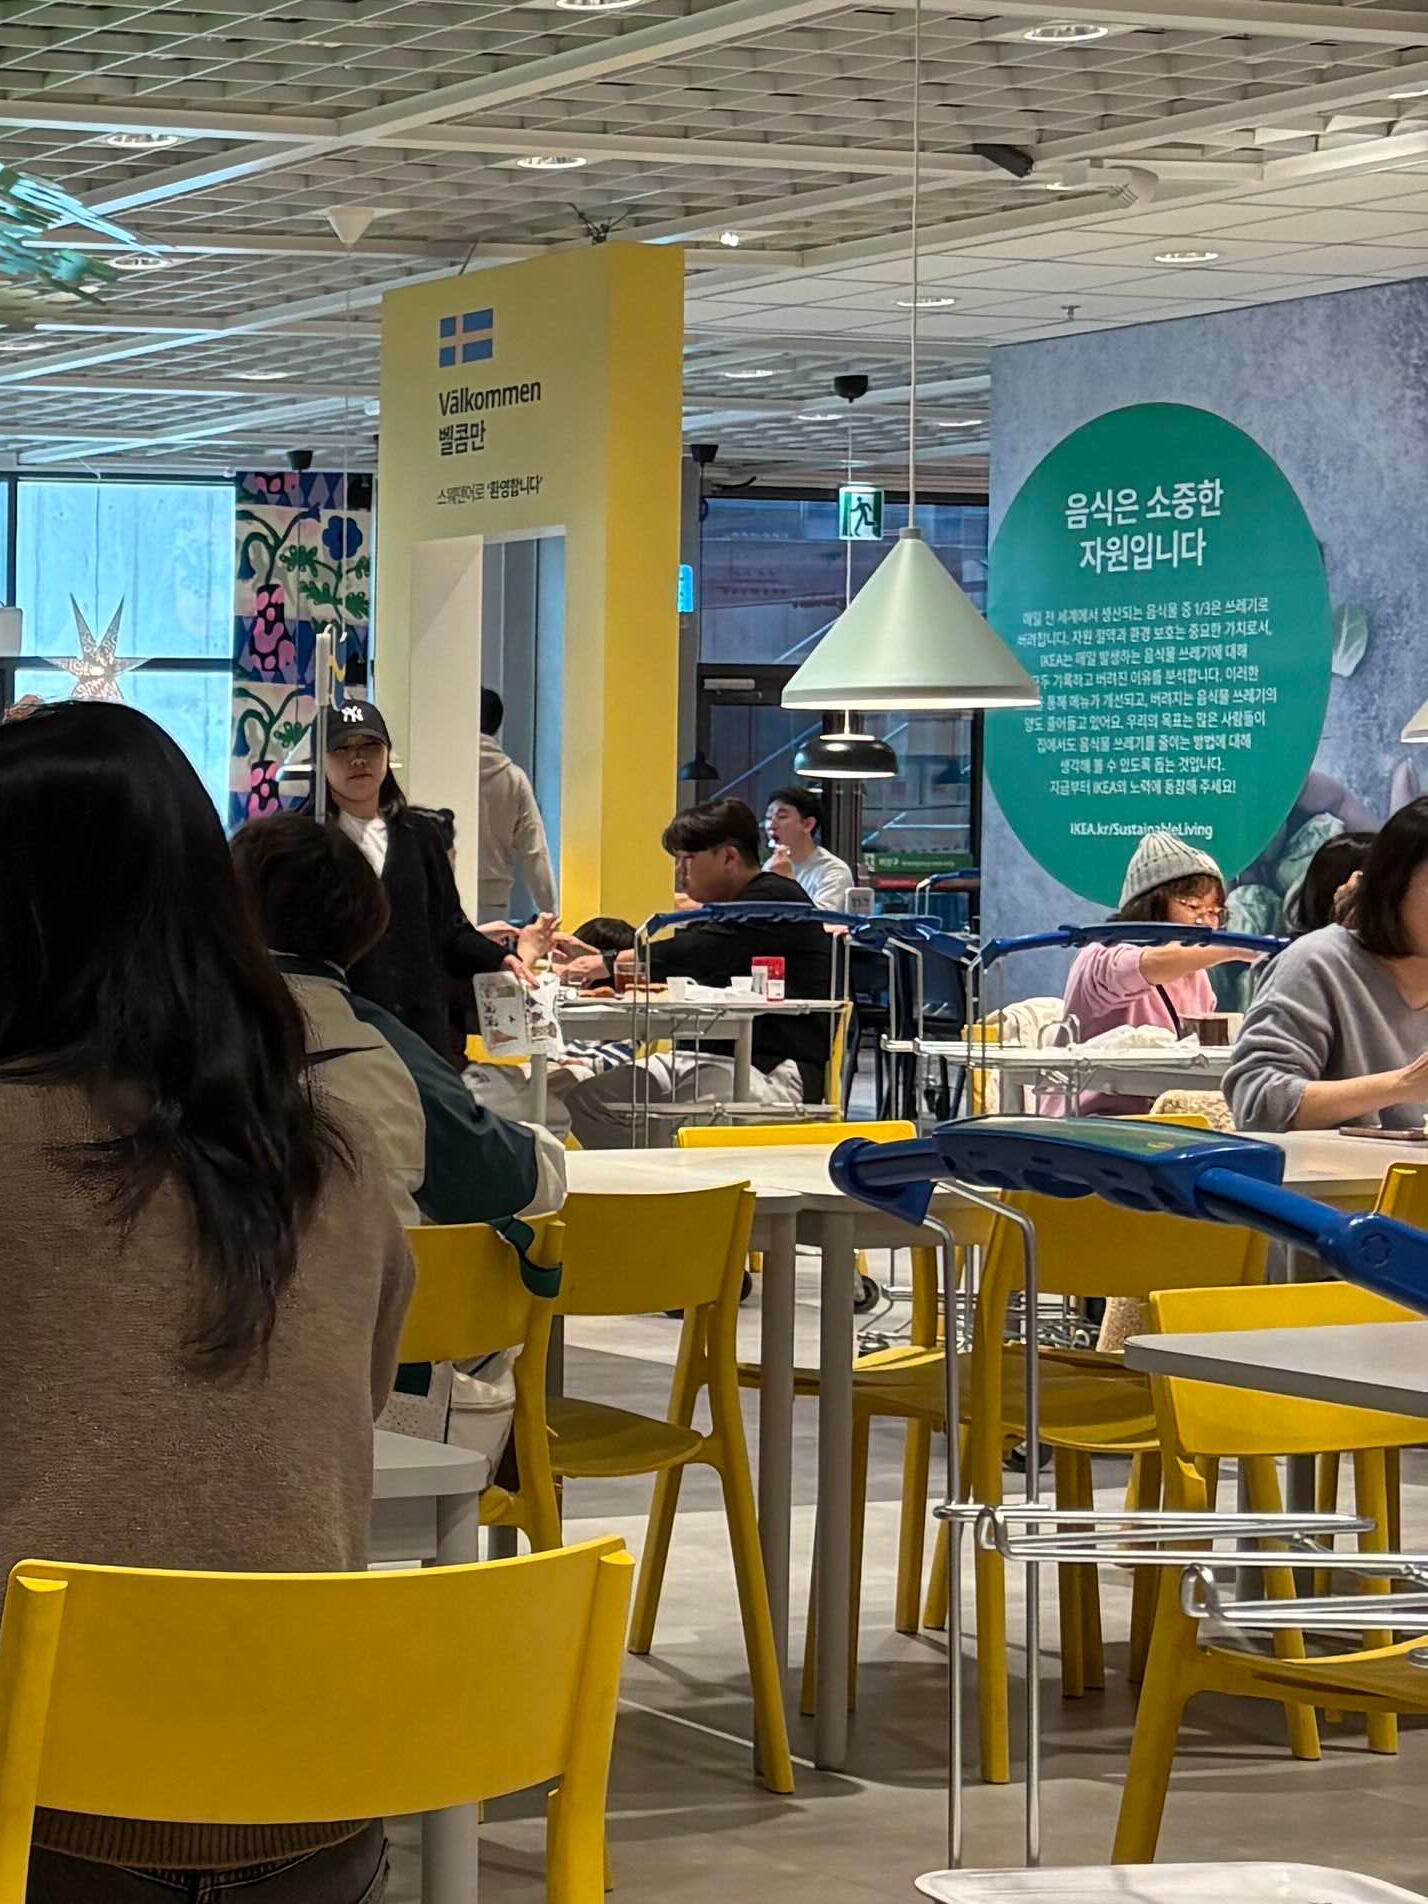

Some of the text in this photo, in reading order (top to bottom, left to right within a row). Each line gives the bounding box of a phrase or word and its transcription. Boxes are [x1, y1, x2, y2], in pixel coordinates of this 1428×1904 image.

[439, 381, 541, 416] Välkommen
[1065, 478, 1224, 529] 음식은 소중한
[1080, 528, 1207, 574] 자원입니다
[1146, 602, 1178, 620] 음식물
[1195, 599, 1221, 616] 1/3은
[1224, 597, 1269, 614] 쓰레기로
[1153, 623, 1186, 640] 보호는
[1144, 646, 1175, 664] 음식물
[1178, 643, 1222, 662] 쓰레기에
[1225, 642, 1248, 659] 대해
[1225, 664, 1259, 682] 이러한
[1197, 688, 1229, 706] 음식물
[1232, 686, 1277, 704] 쓰레기의
[1221, 709, 1265, 728] 사람들이
